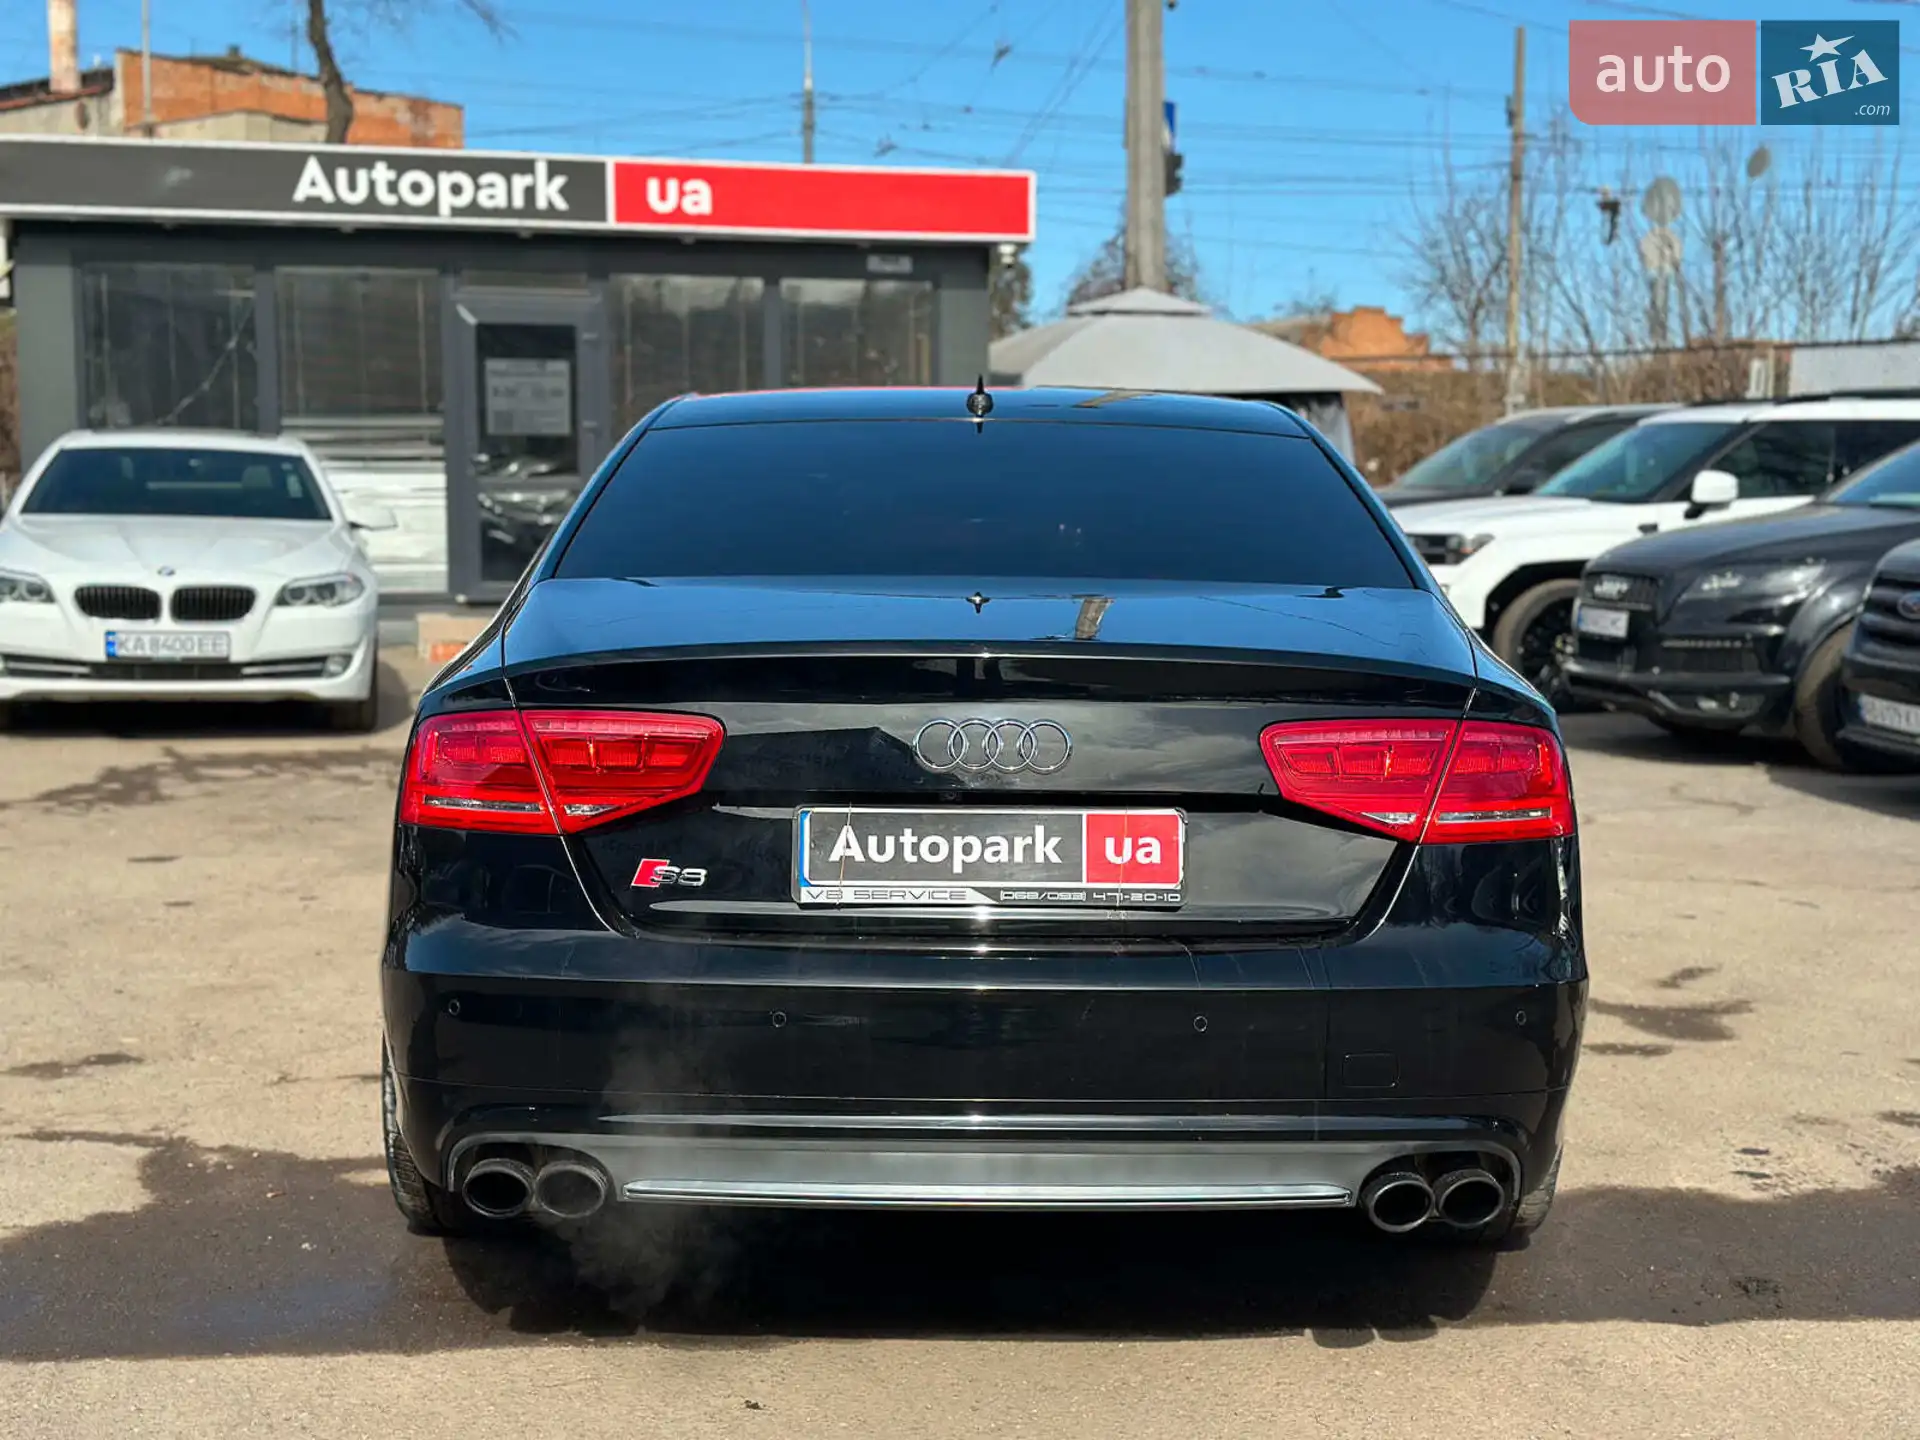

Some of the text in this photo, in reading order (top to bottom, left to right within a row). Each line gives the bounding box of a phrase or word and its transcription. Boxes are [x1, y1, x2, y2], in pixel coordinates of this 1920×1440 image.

[293, 154, 713, 217] Autopark ua
[828, 823, 1162, 874] Autopark ua
[648, 864, 708, 887] S8
[853, 889, 967, 901] SERVICE
